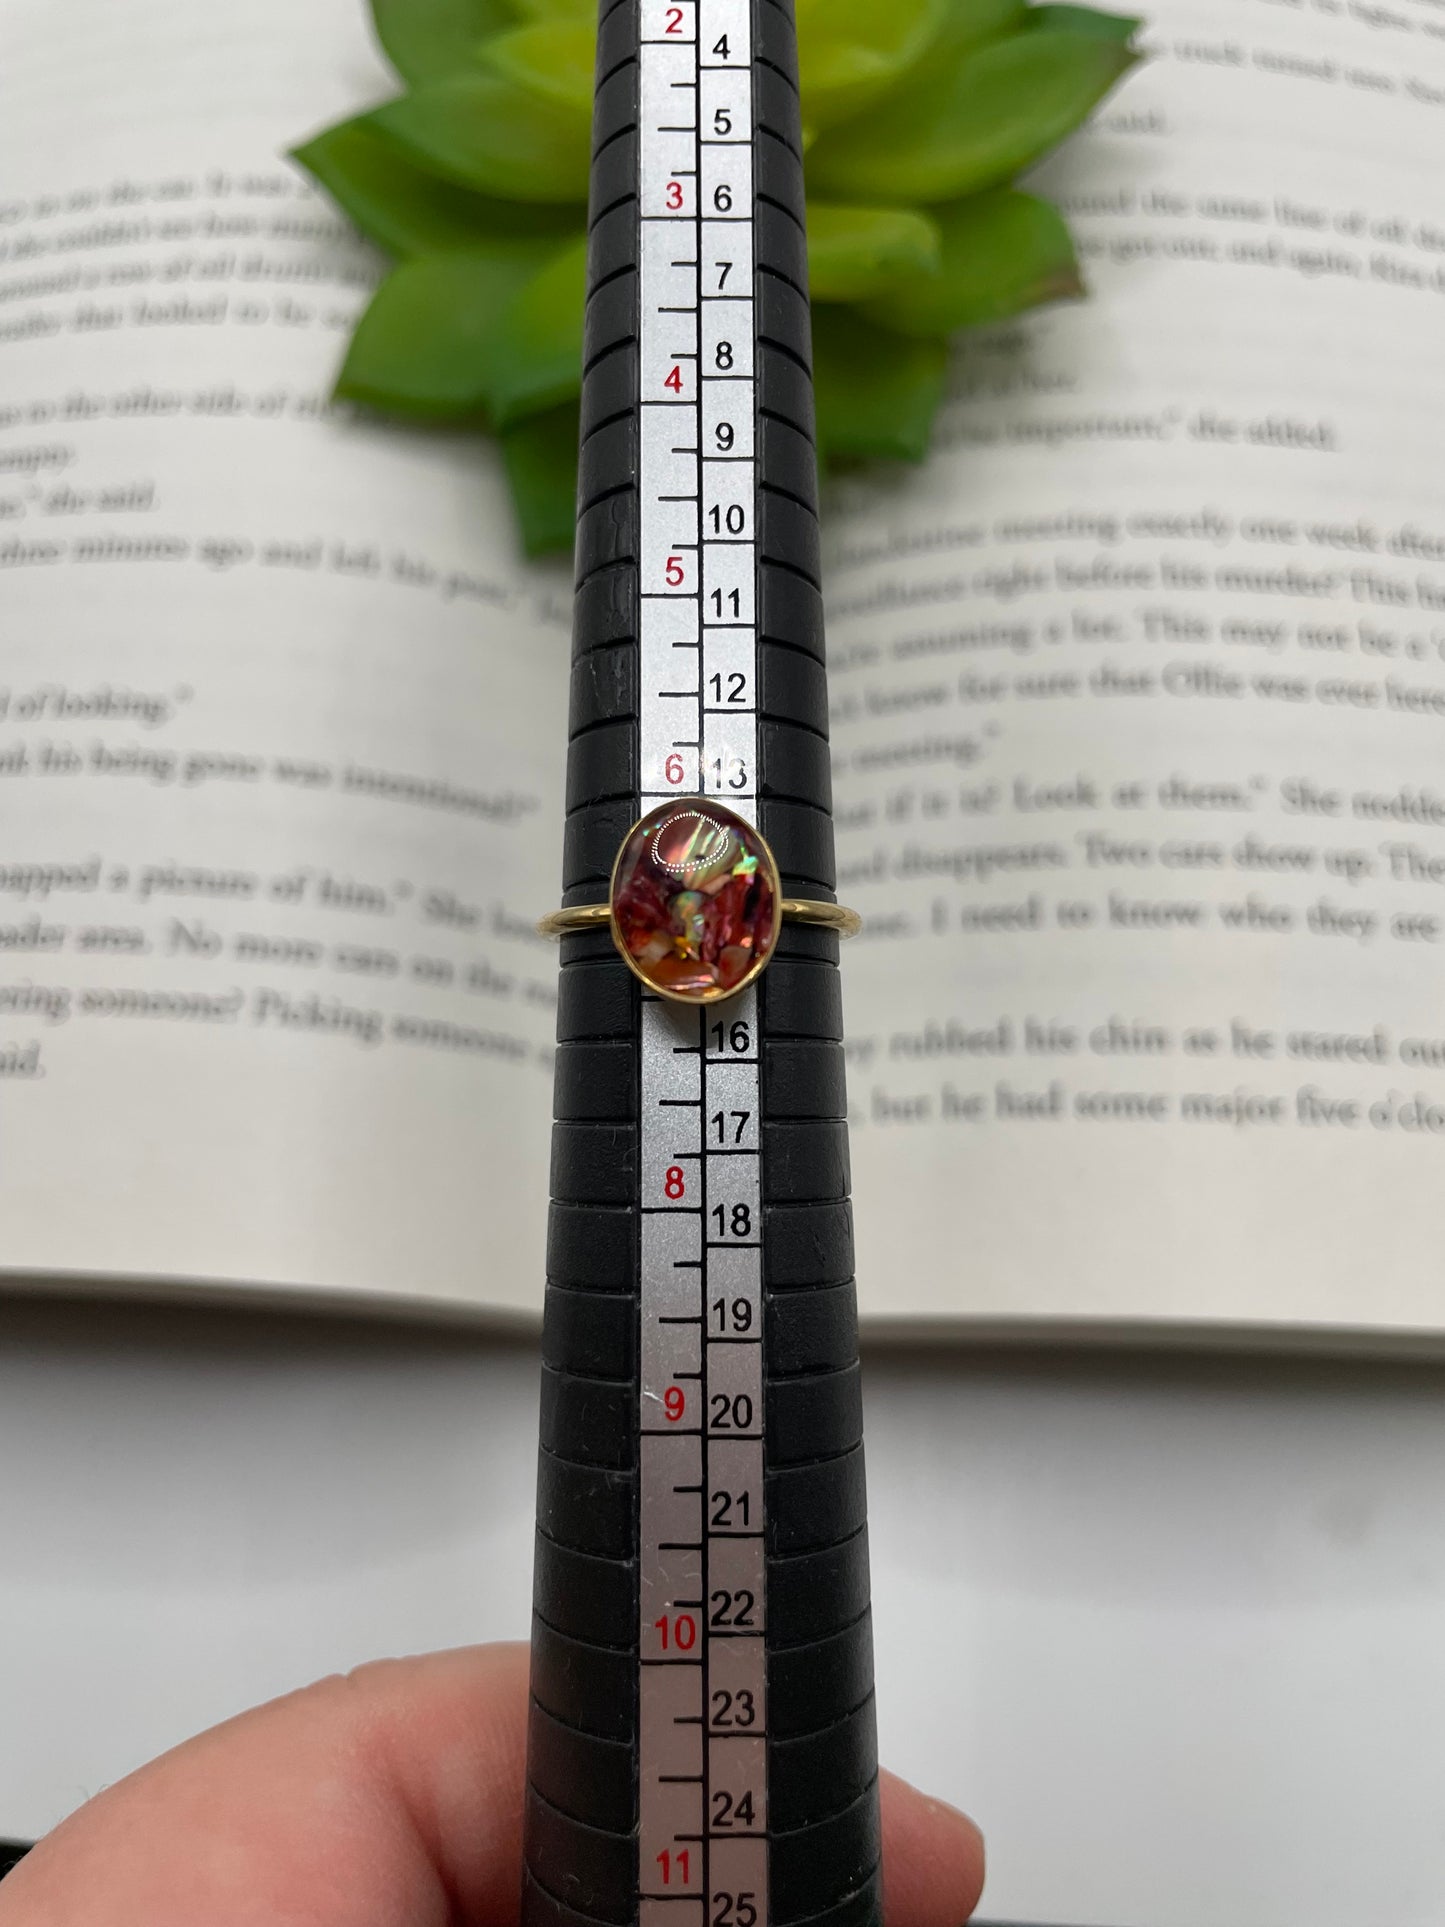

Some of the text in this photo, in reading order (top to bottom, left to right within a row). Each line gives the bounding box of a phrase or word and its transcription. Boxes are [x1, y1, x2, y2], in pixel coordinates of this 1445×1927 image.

[665, 8, 684, 34] 2
[712, 33, 731, 60] 4
[713, 108, 732, 136] 5
[665, 181, 684, 210] 3
[713, 184, 733, 213] 6
[714, 261, 733, 290] 7
[715, 340, 734, 371] 8
[663, 364, 684, 394] 4
[714, 422, 735, 452] 9
[708, 503, 745, 535] 10
[665, 556, 685, 587] 5
[710, 587, 740, 618] 11
[709, 672, 747, 703] 12
[665, 753, 685, 785] 6
[710, 757, 748, 790] 13
[710, 1020, 751, 1054] 16
[710, 1110, 751, 1144] 17
[663, 1165, 686, 1201] 8
[711, 1202, 752, 1238] 18
[712, 1297, 753, 1333] 19
[662, 1385, 686, 1423] 9
[710, 1393, 753, 1429] 20
[711, 1490, 750, 1527] 21
[710, 1589, 755, 1627] 22
[653, 1612, 697, 1653] 10
[711, 1689, 756, 1728] 23
[711, 1790, 756, 1828] 24
[654, 1845, 697, 1889] 11
[712, 1891, 758, 1927] 25
